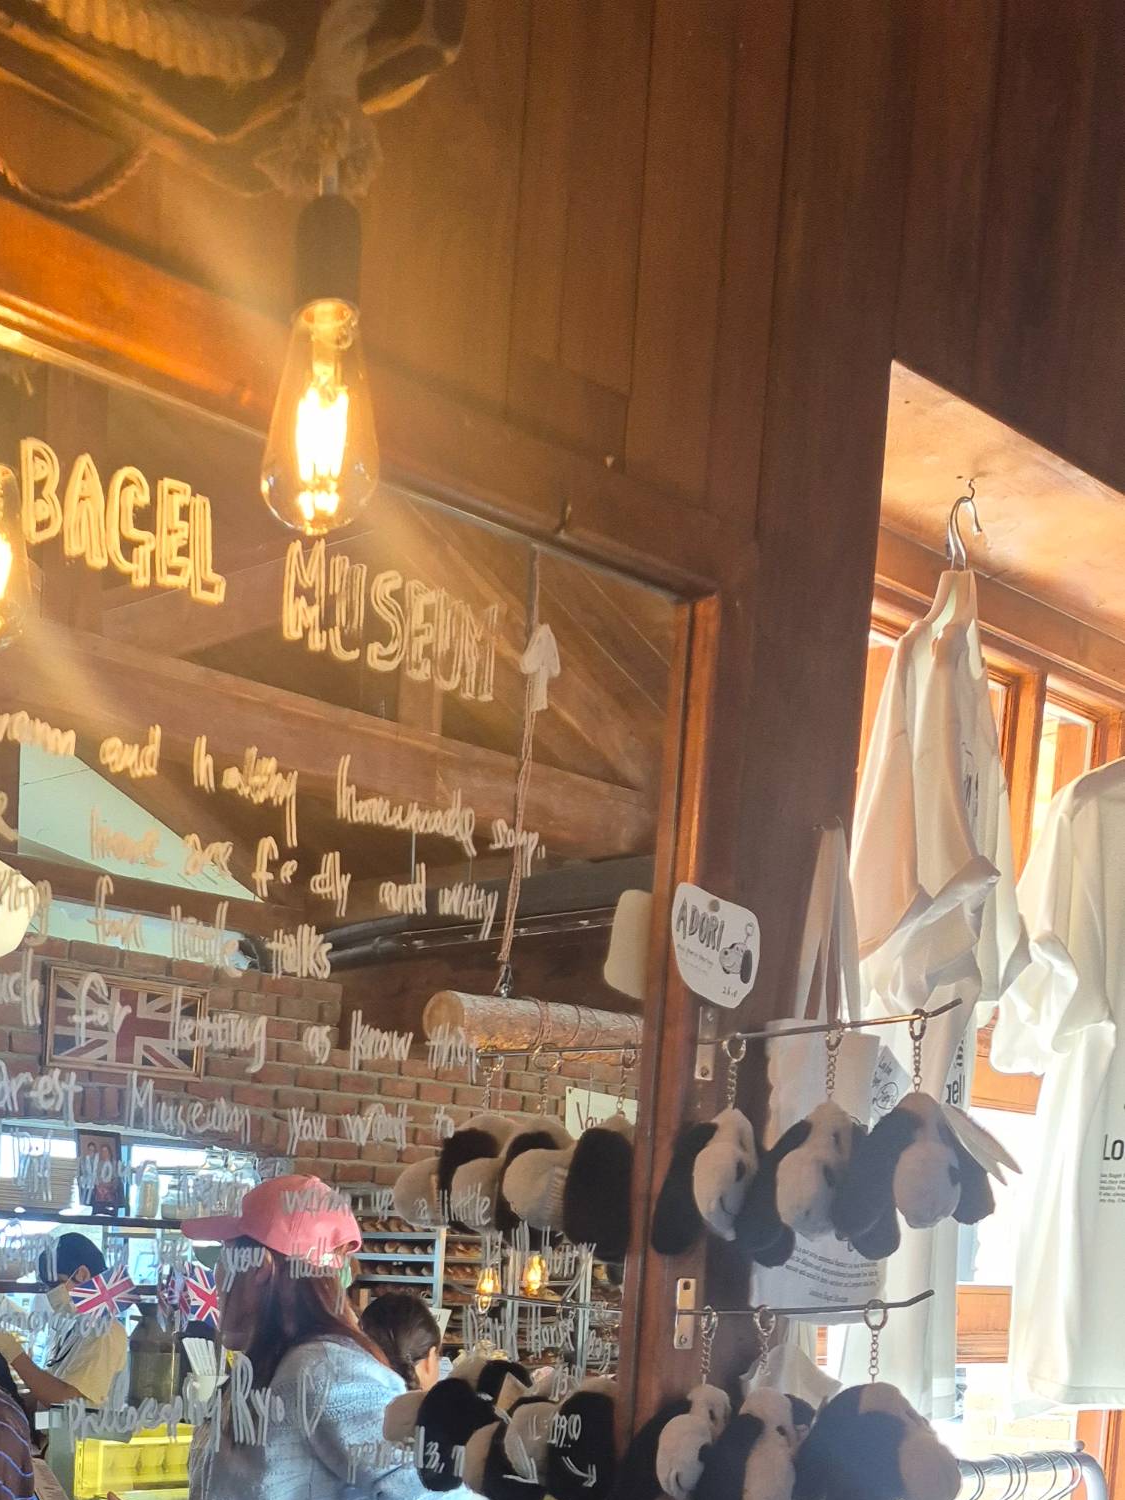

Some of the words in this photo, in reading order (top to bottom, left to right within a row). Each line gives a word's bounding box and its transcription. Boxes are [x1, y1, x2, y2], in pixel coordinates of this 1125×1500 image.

[21, 437, 226, 604] BAGEL
[283, 538, 503, 701] MUSEUM
[100, 724, 162, 778] and
[379, 862, 427, 915] and
[676, 897, 725, 953] ADORI
[69, 972, 133, 1048] for
[350, 1009, 414, 1071] know
